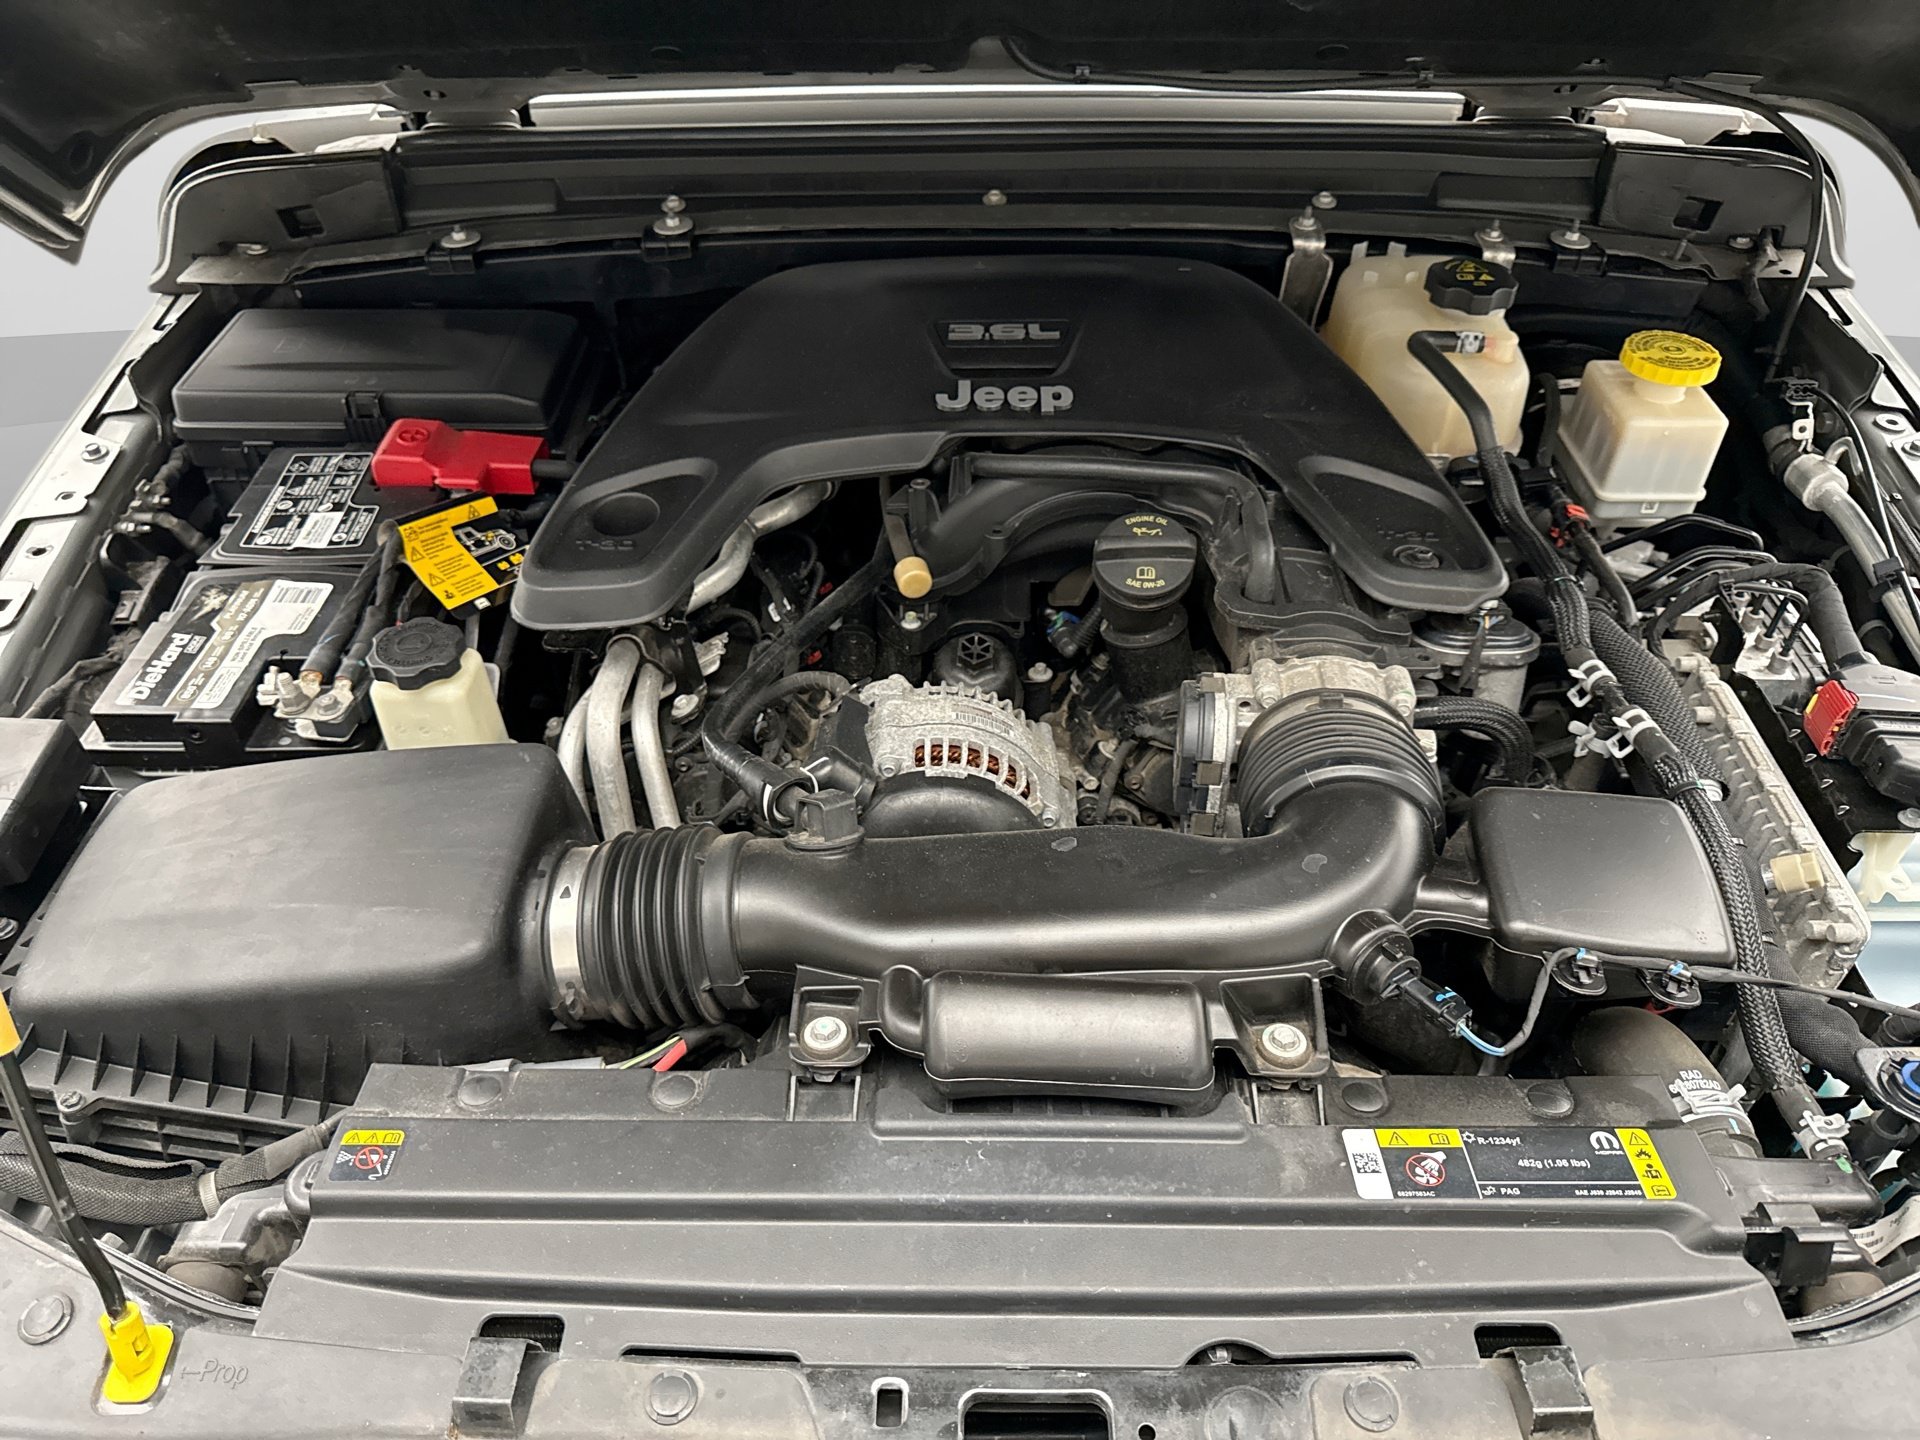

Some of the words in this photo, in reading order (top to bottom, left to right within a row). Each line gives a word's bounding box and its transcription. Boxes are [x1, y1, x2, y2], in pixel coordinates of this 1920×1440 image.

[948, 323, 1060, 340] 3.6L
[935, 379, 1074, 415] Jeep
[1125, 515, 1154, 525] ENGINE
[1155, 516, 1168, 526] OIL
[1125, 578, 1142, 588] SAE
[1142, 578, 1165, 589] 0W-20
[127, 632, 192, 701] DieHard
[1679, 1070, 1702, 1080] RAD
[1477, 1136, 1521, 1146] R-1234yf
[1518, 1159, 1543, 1168] 482g
[1570, 1159, 1590, 1168] lbs)
[1500, 1187, 1520, 1195] PAG
[200, 1358, 249, 1389] Prop
